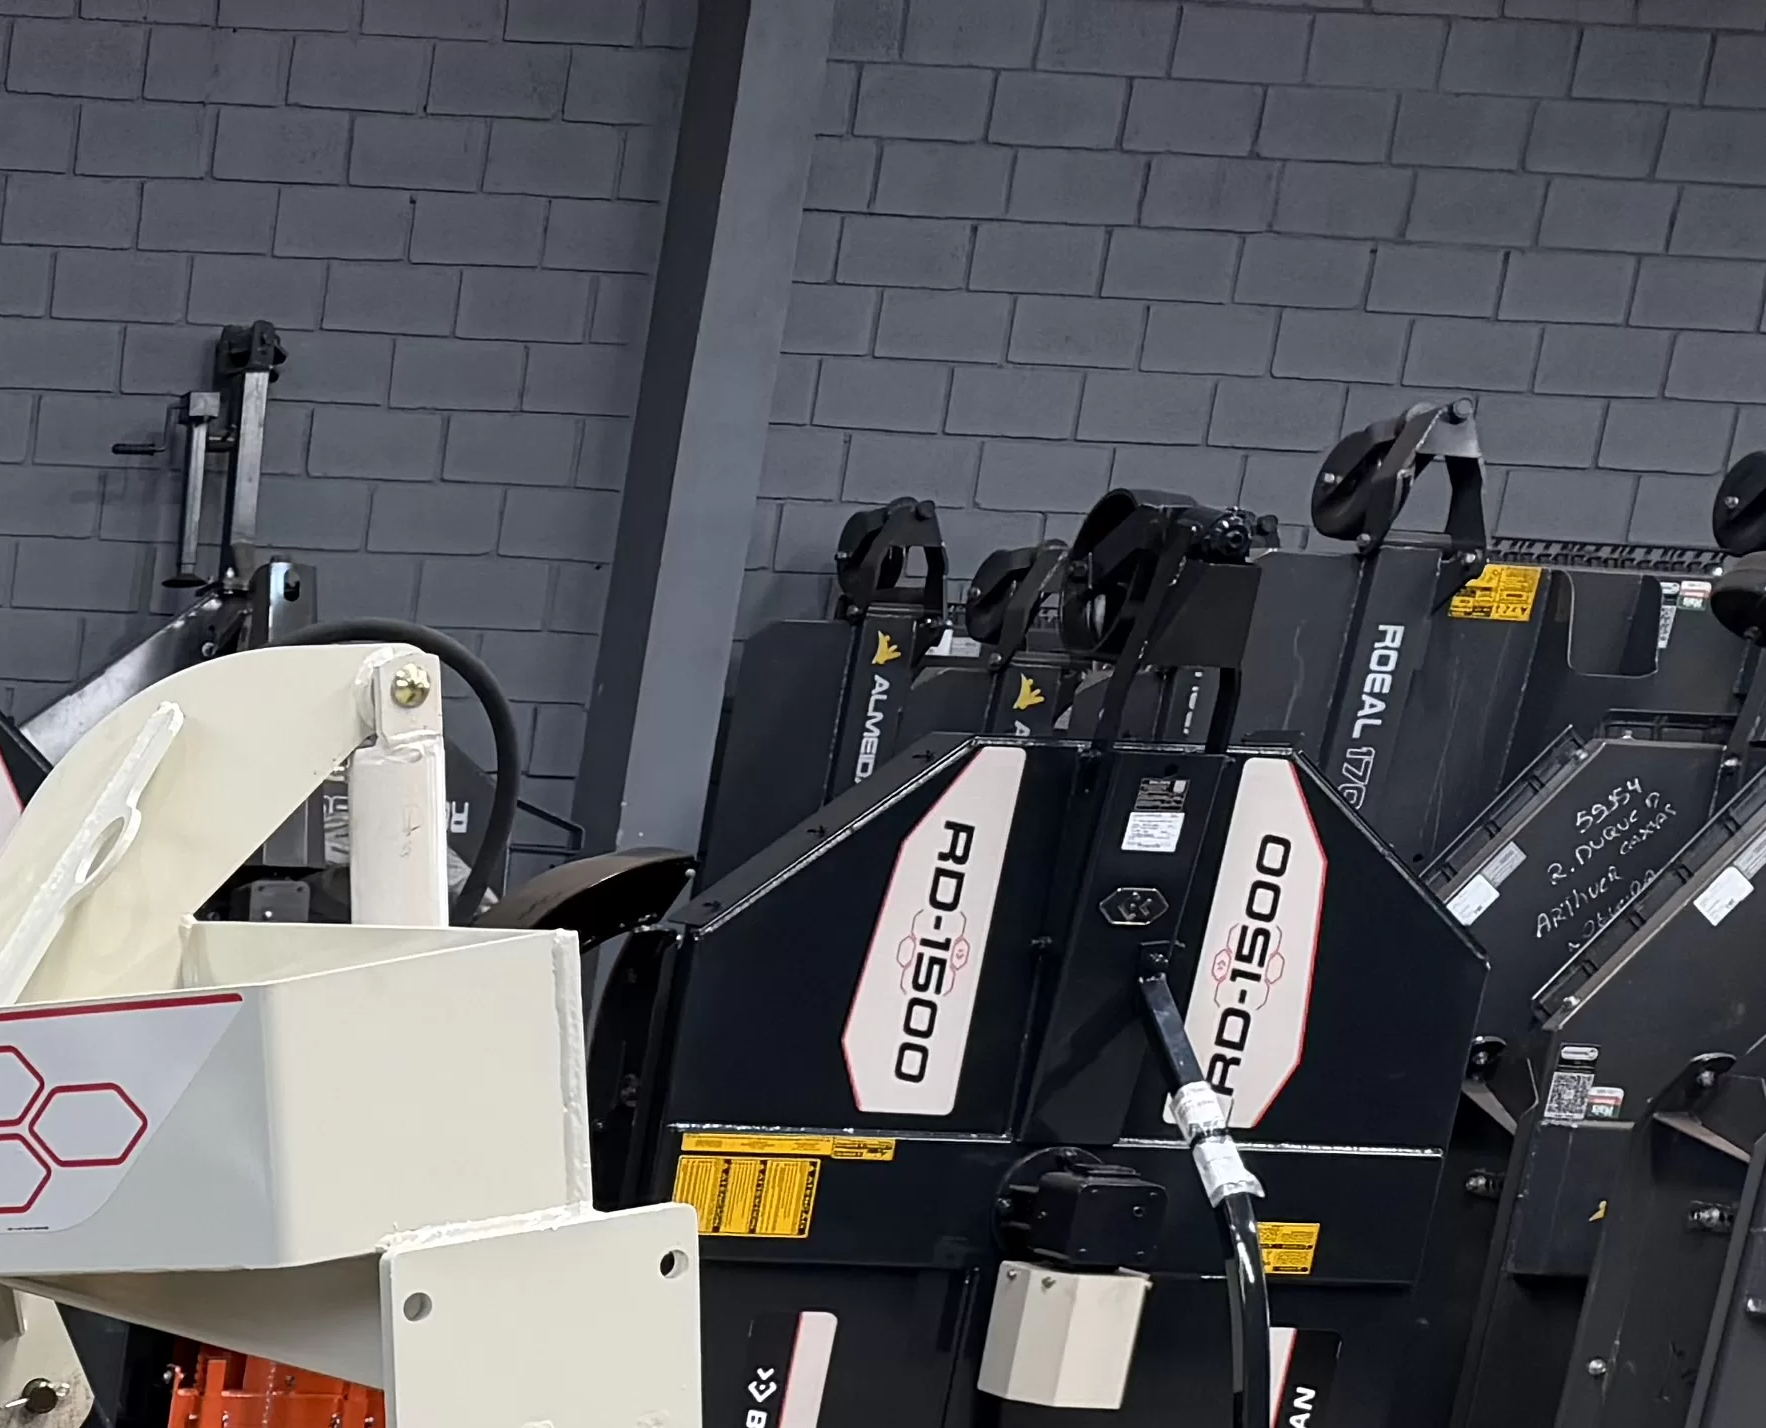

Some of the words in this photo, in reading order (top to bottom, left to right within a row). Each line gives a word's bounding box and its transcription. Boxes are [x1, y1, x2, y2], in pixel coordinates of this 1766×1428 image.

[855, 673, 890, 783] ALMEID
[1352, 624, 1404, 739] ROEAL
[894, 819, 976, 1085] RD-1500
[1206, 833, 1292, 1097] RD-1500
